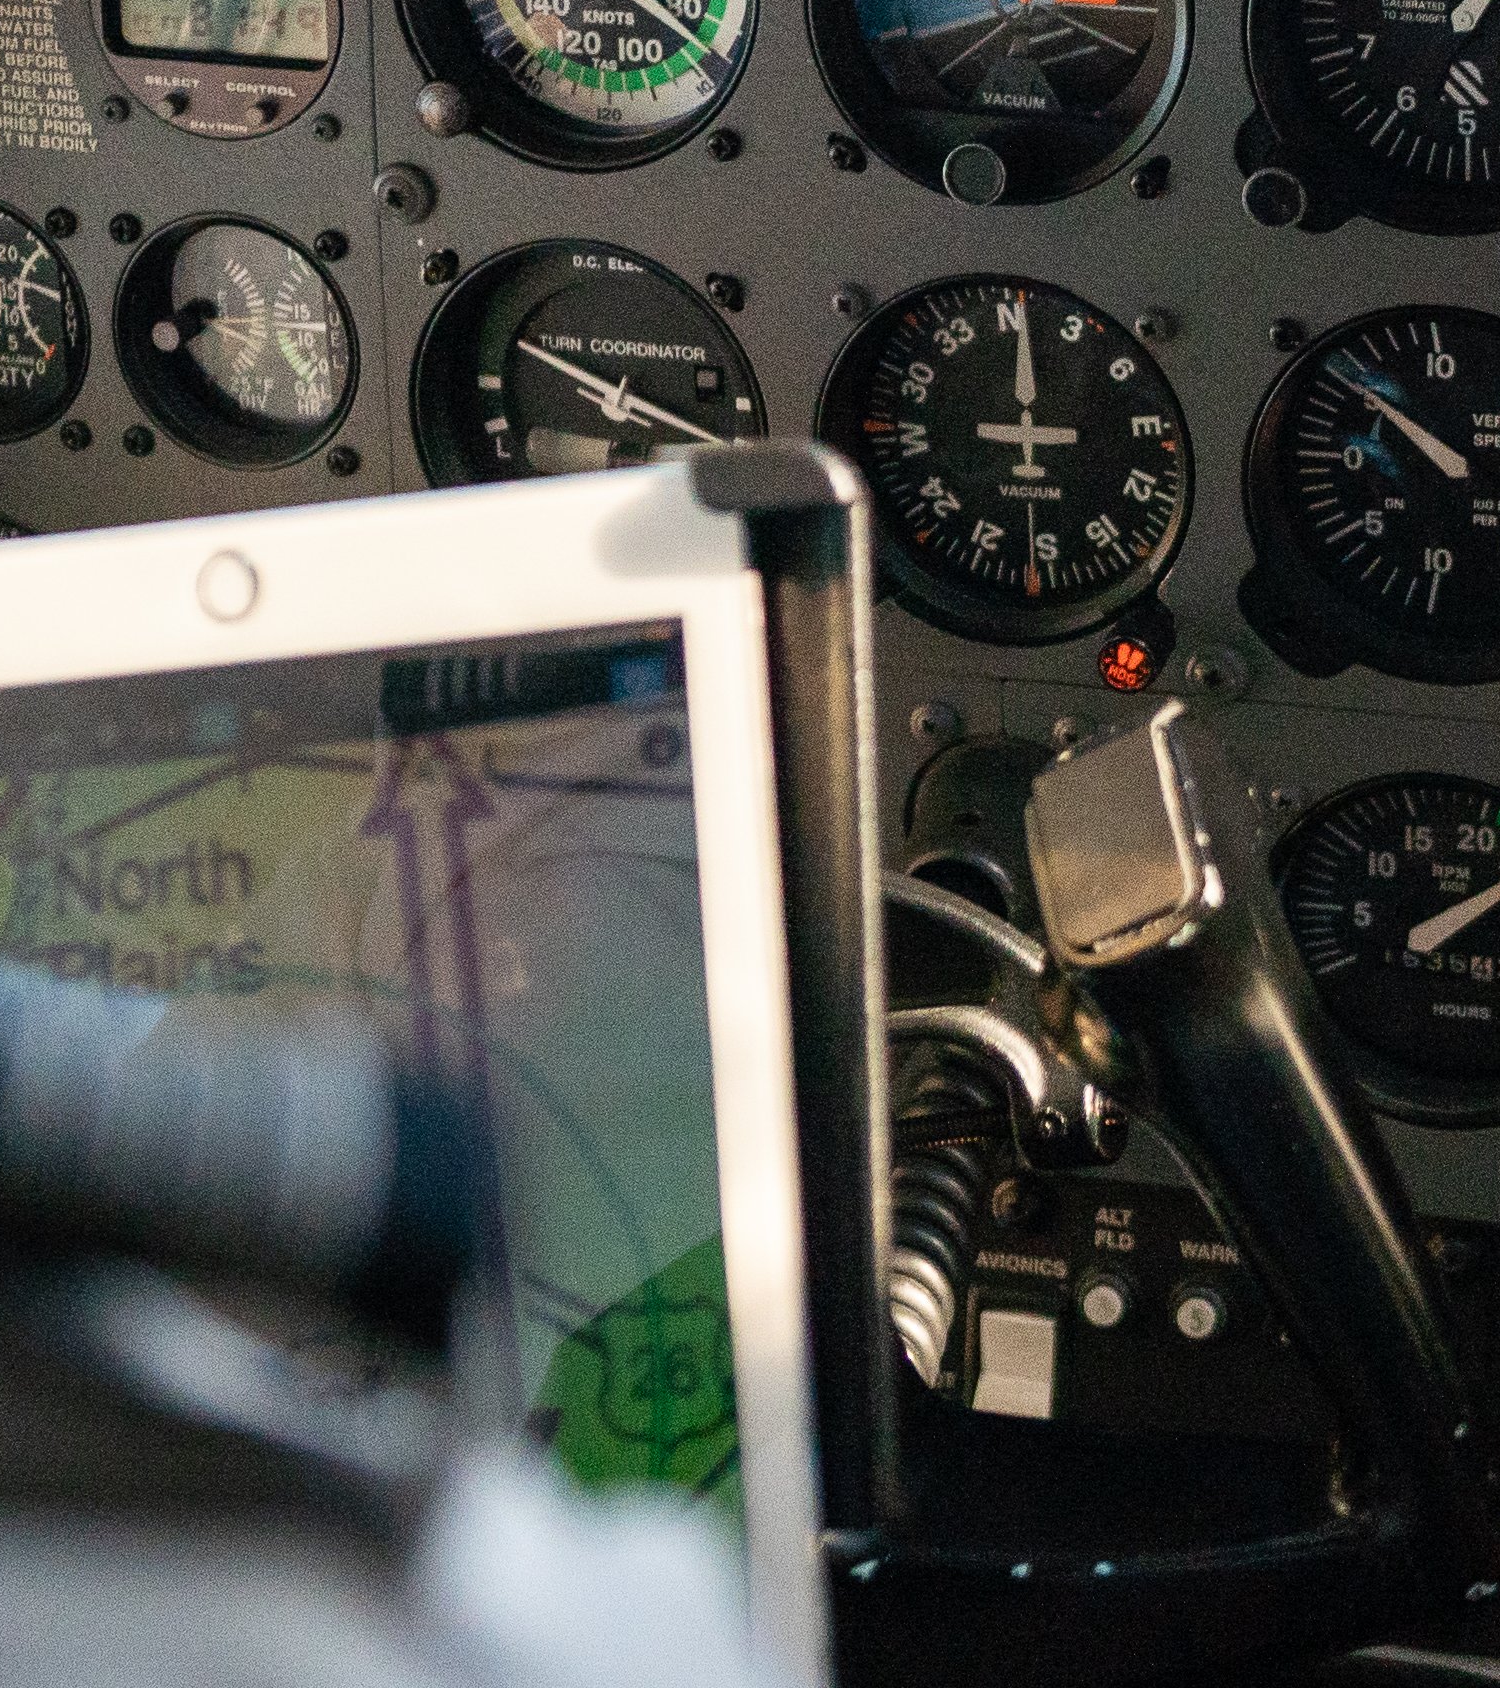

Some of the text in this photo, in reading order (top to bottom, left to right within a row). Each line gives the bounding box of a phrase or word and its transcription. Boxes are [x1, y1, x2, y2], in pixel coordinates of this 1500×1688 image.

[583, 10, 635, 27] KNOTS
[618, 37, 662, 62] 100
[145, 75, 296, 98] SELECT CONTROL
[981, 92, 1046, 111] VACUUM
[934, 316, 976, 354] 33
[540, 334, 706, 362] TURN COORDINATOR
[1426, 352, 1456, 380] 10
[902, 362, 935, 404] 30
[998, 484, 1062, 500] VACUUM
[1404, 824, 1497, 852] 15 20
[56, 834, 256, 914] North
[1432, 1003, 1492, 1021] HOURS
[1094, 1208, 1134, 1229] ALT
[974, 1250, 1067, 1280] AVIONICS
[1180, 1240, 1239, 1265] WARN
